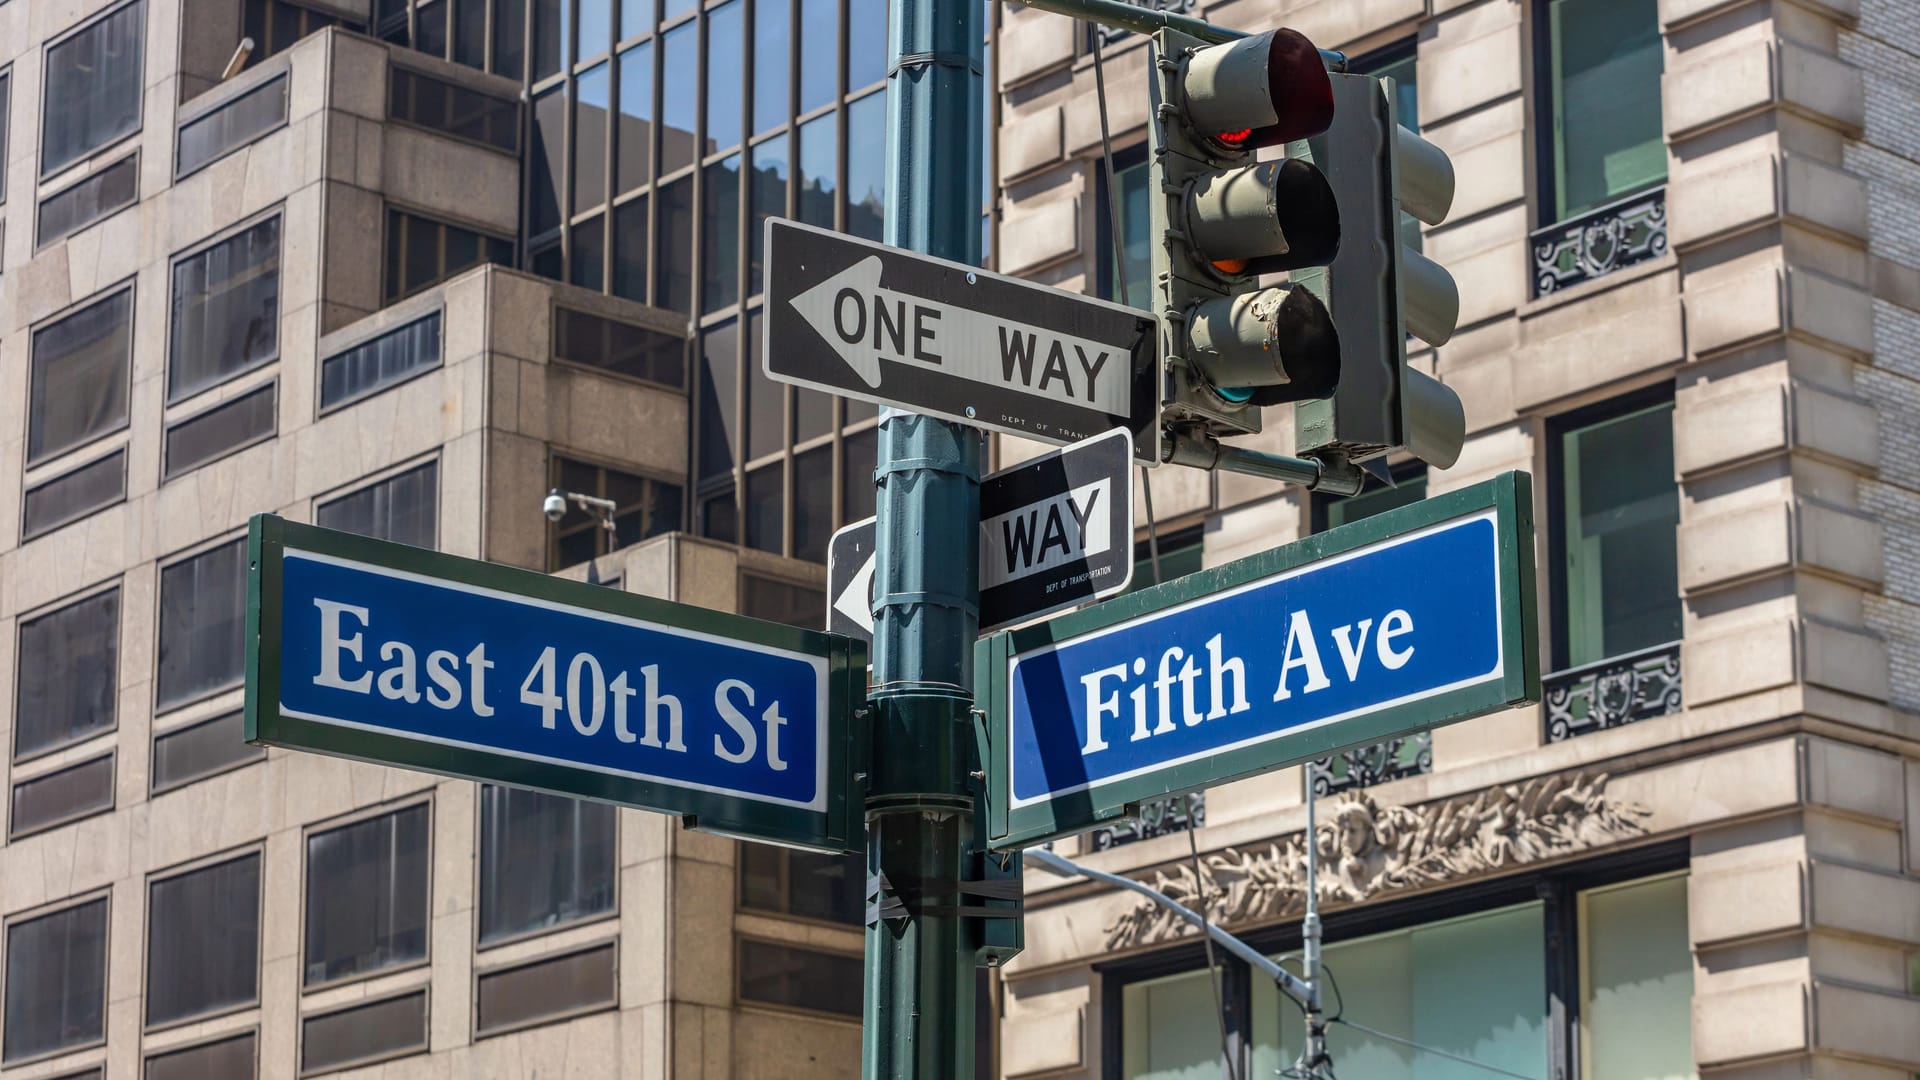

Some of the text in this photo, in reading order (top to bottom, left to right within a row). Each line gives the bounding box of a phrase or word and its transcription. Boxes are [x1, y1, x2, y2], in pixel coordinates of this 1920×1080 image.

[833, 287, 1110, 403] ONE WAY
[1001, 414, 1048, 431] DEPT OF
[1001, 487, 1101, 575] WAY
[1045, 564, 1112, 594] DEPT OF TRANSPORTATION
[313, 597, 788, 771] East 40th St
[1080, 609, 1415, 756] Fifth Ave
